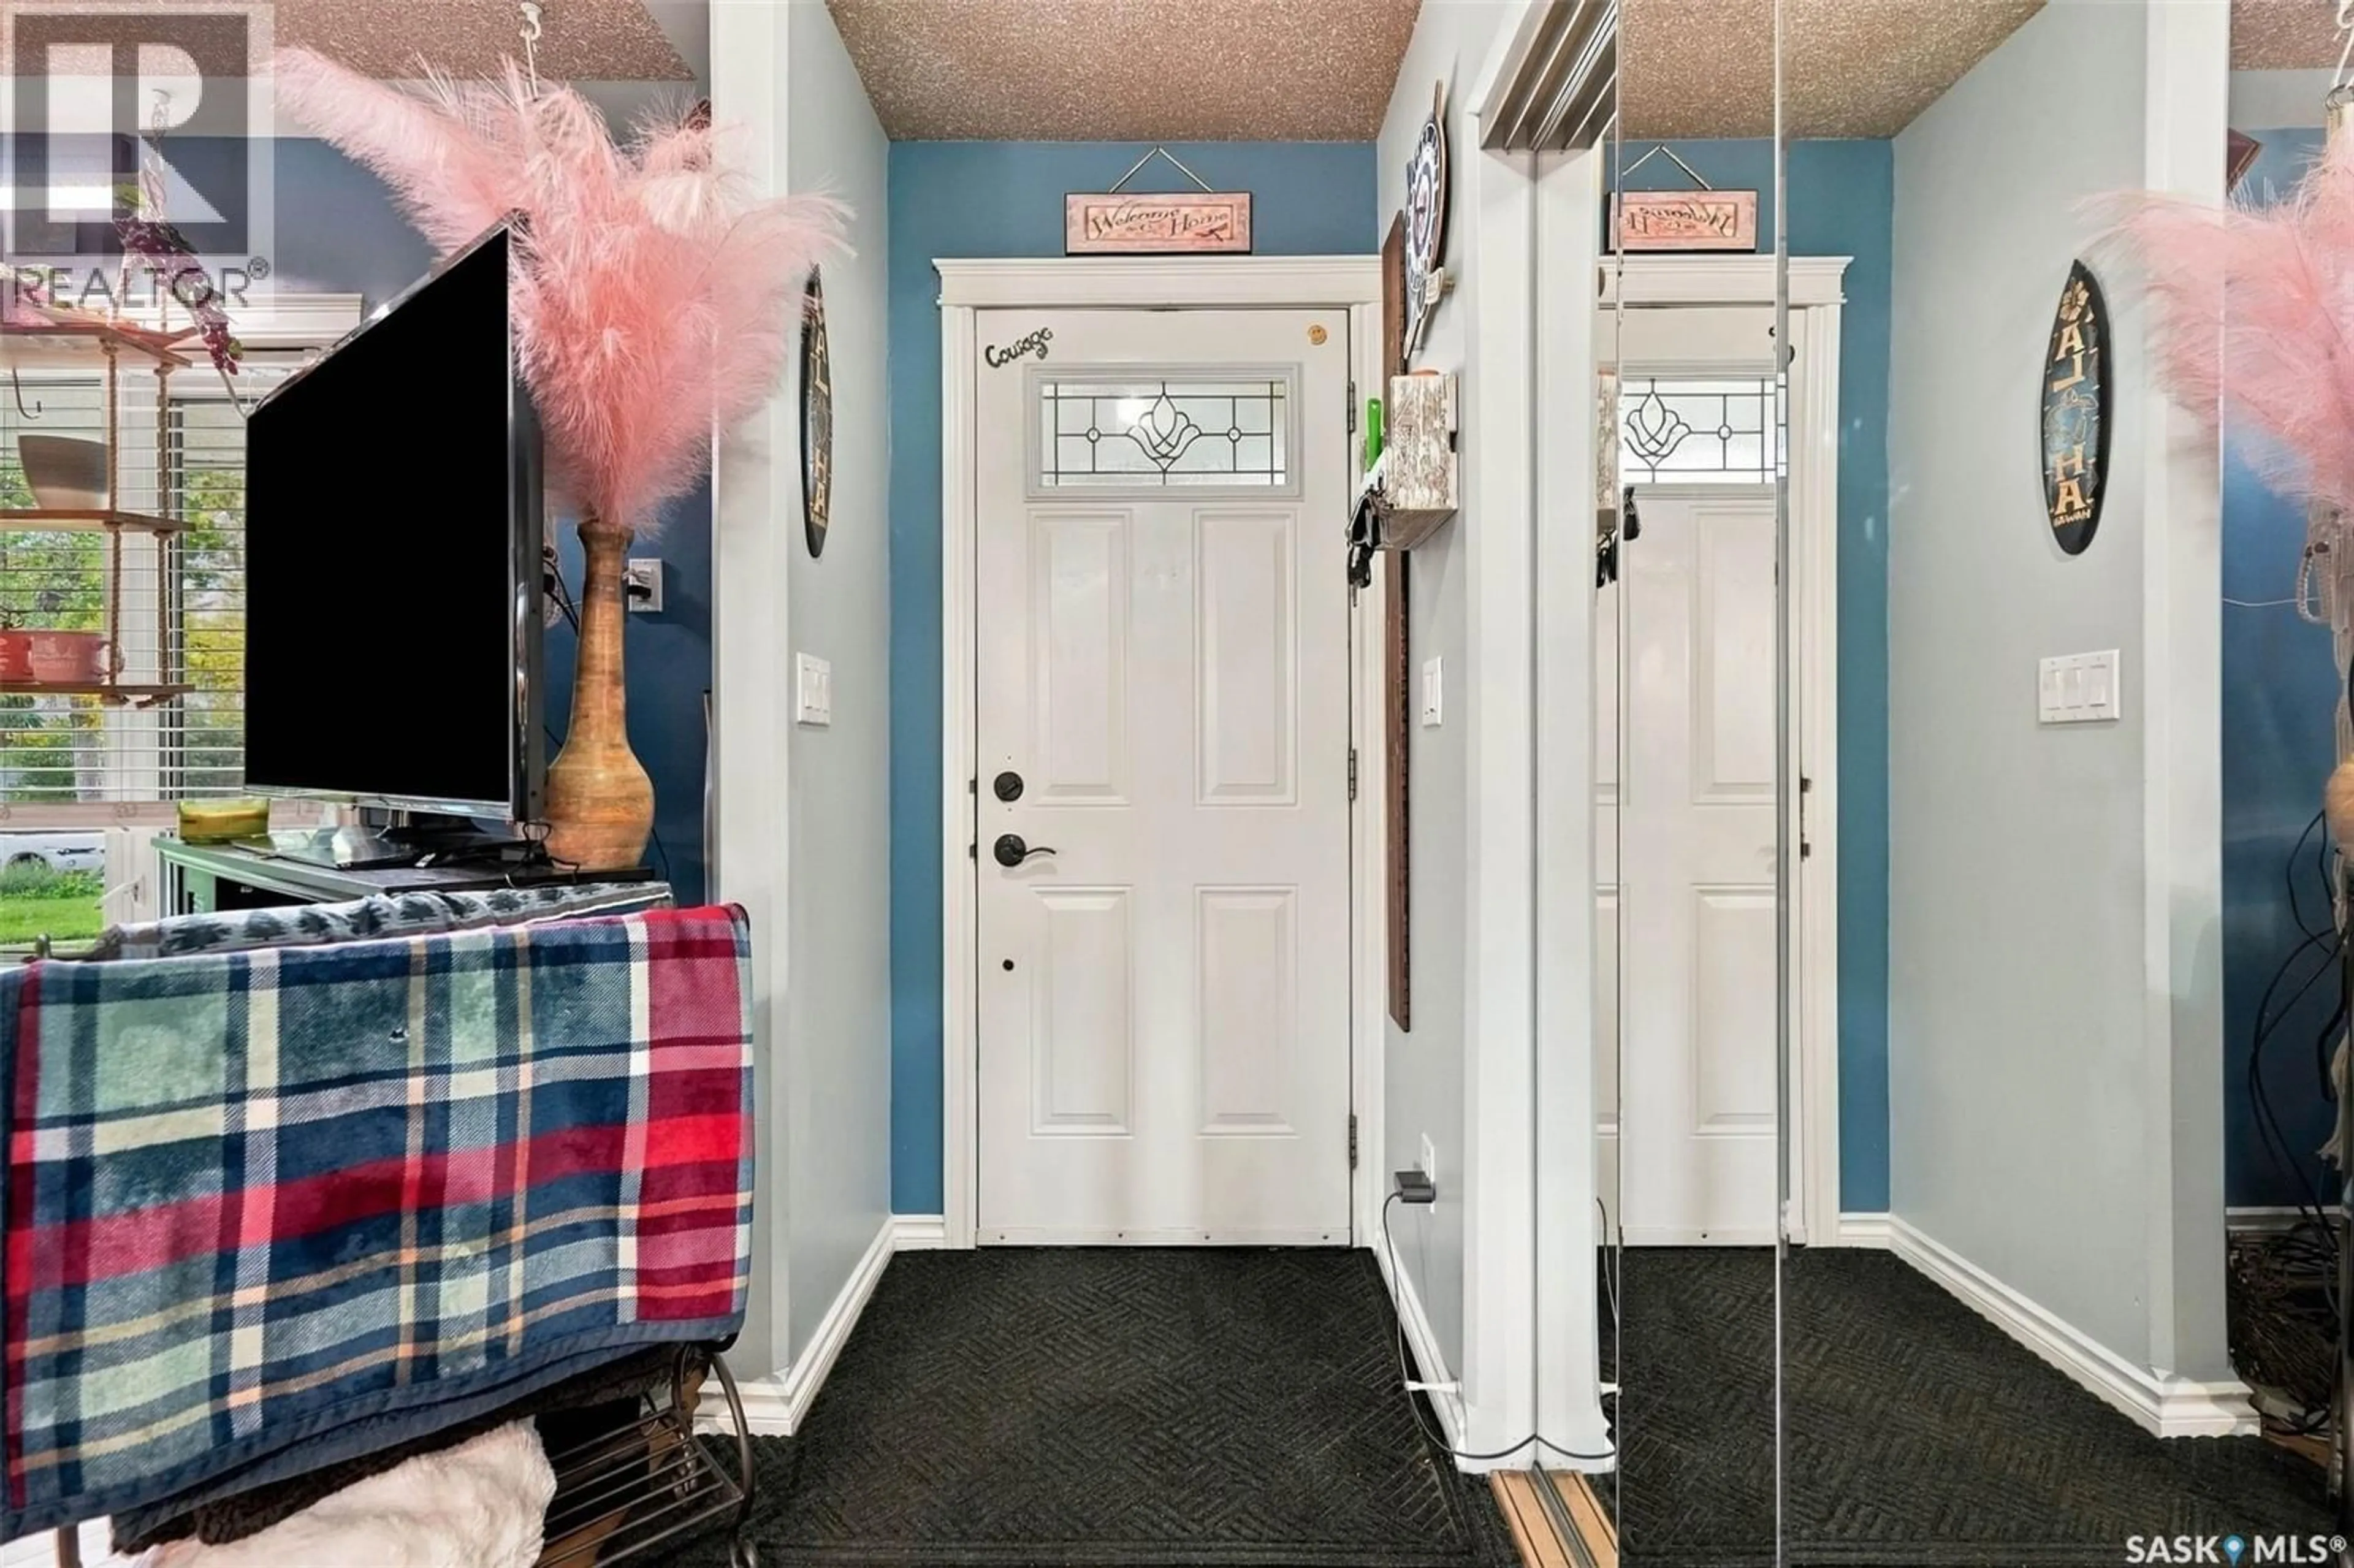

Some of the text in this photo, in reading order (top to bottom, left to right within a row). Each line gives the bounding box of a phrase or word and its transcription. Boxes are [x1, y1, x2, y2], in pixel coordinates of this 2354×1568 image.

[1092, 200, 1228, 238] Welcome Home
[985, 327, 1054, 369] Courage
